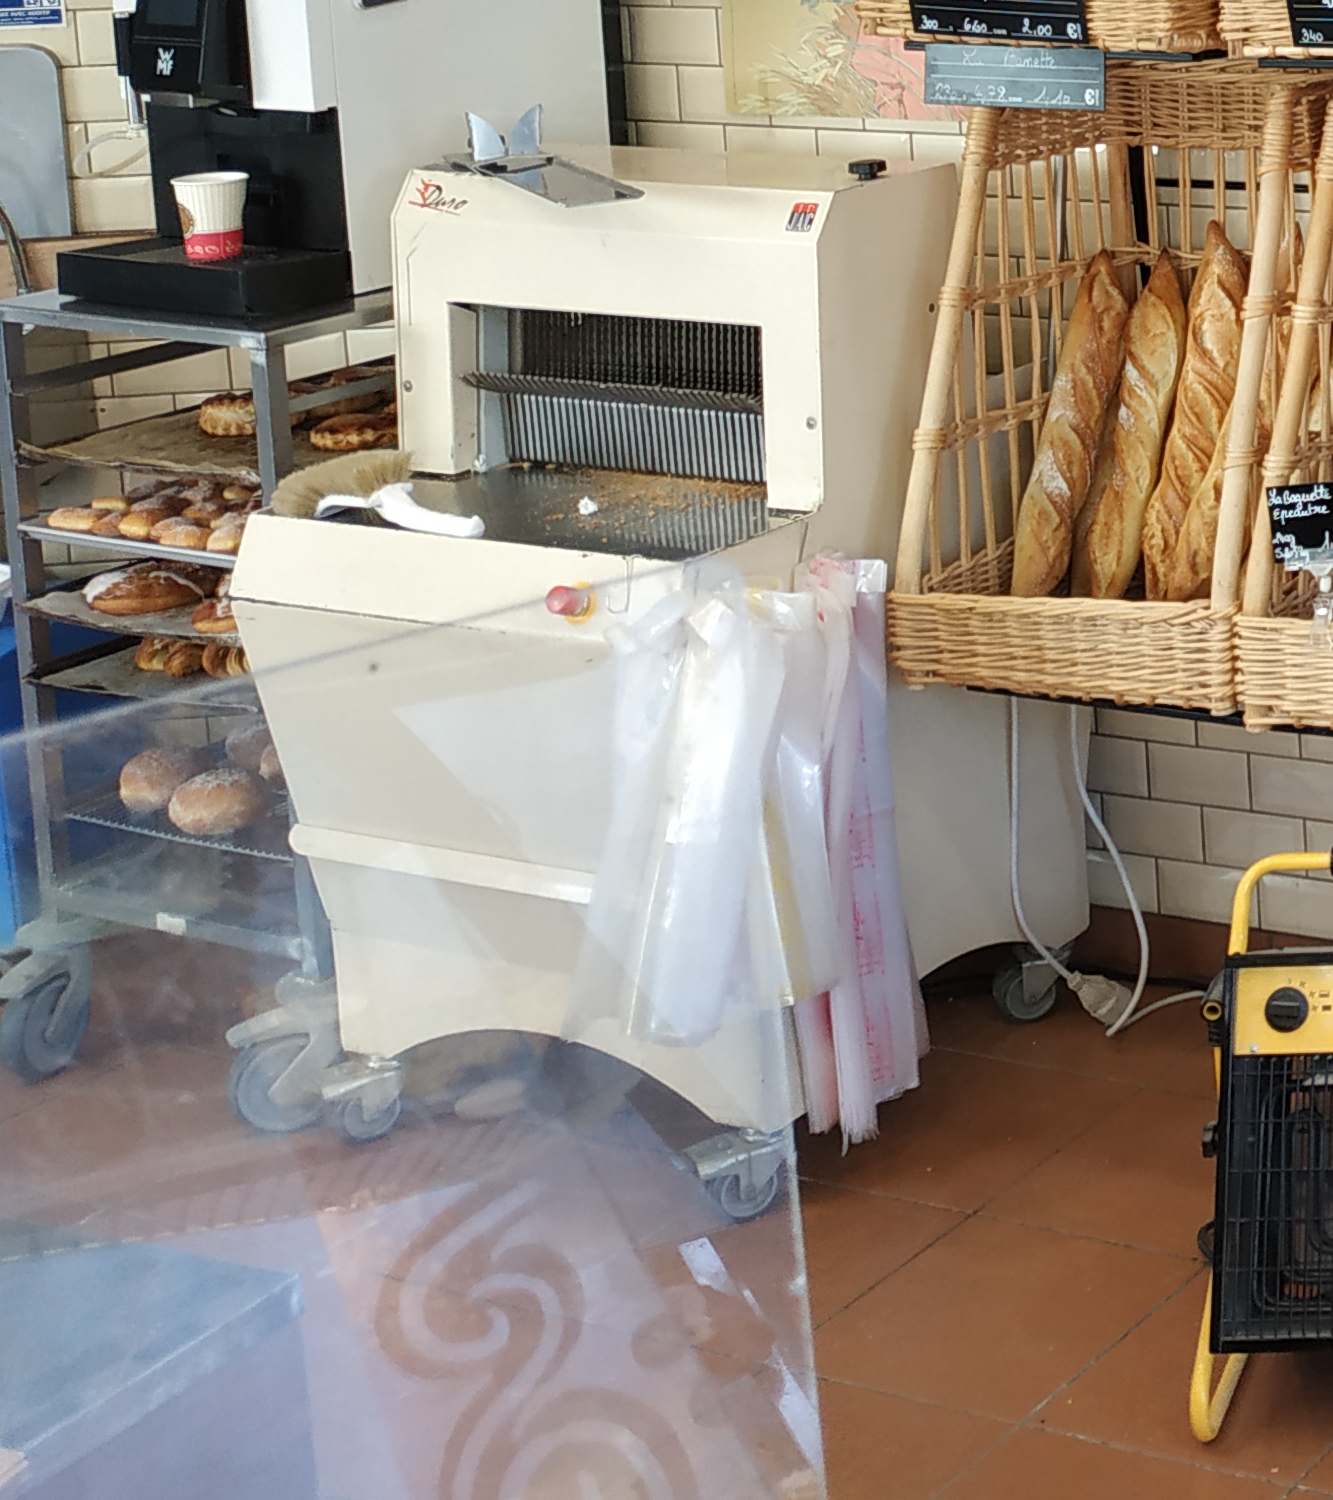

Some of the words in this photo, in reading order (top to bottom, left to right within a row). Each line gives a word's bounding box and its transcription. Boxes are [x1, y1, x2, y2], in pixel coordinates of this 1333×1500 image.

[1067, 23, 1077, 39] €
[1301, 28, 1325, 43] 340
[1084, 89, 1095, 106] €
[787, 212, 814, 231] JAC
